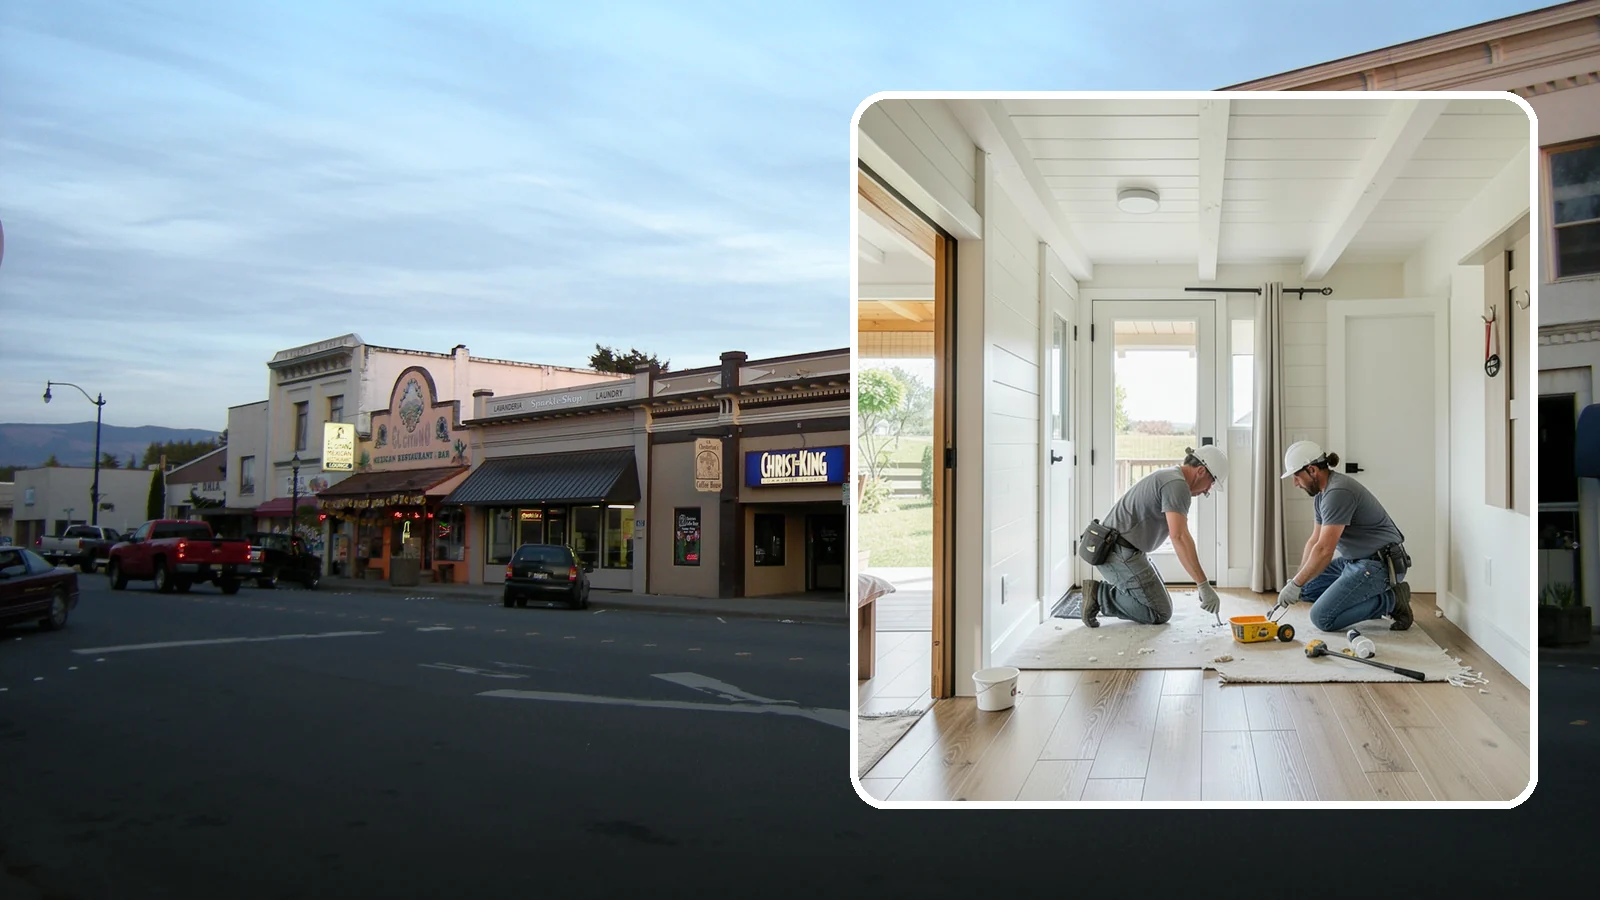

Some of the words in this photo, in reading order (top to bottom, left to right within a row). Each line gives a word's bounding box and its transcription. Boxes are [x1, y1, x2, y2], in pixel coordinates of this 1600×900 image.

[493, 402, 523, 413] LAVANDERIA
[531, 398, 560, 409] Sparkle
[561, 395, 583, 406] Shop
[595, 389, 624, 400] LAUNDRY
[373, 455, 396, 464] MEXICAN
[397, 452, 434, 462] RESTAURANT
[437, 450, 450, 459] BAR
[760, 452, 797, 478] CHRIST
[799, 450, 827, 476] KING
